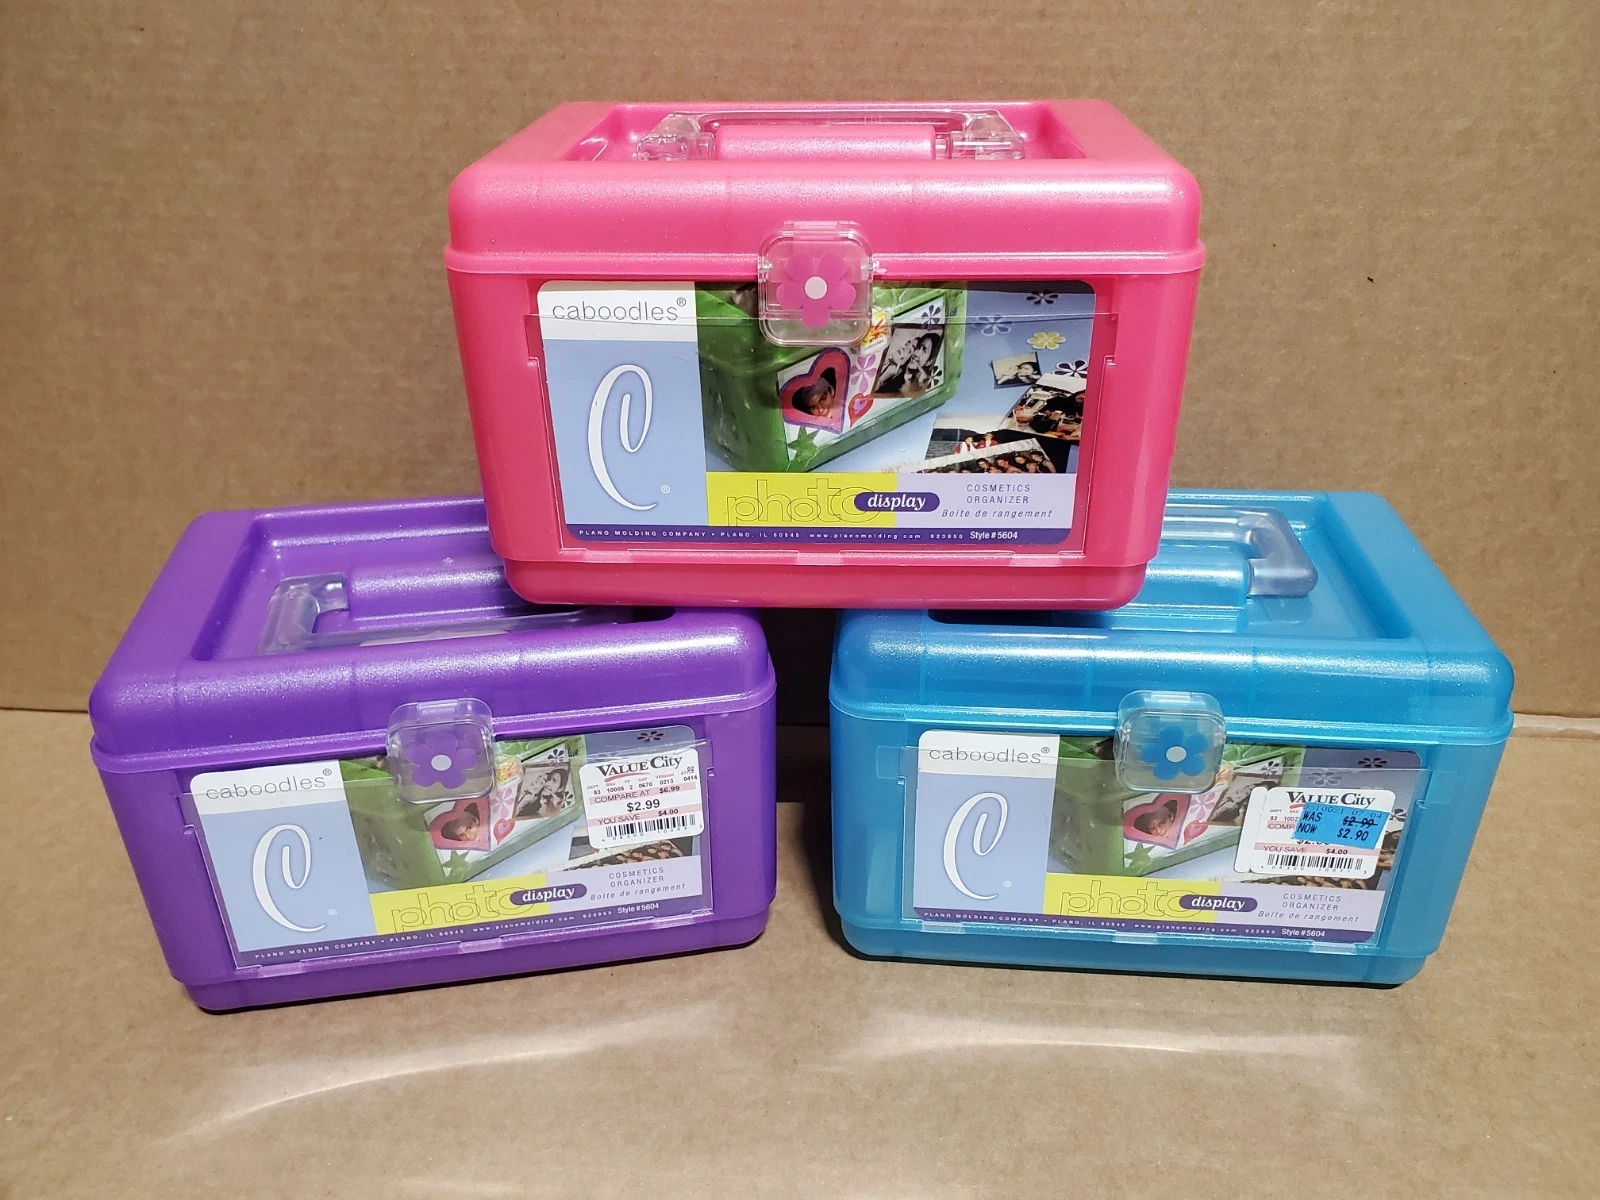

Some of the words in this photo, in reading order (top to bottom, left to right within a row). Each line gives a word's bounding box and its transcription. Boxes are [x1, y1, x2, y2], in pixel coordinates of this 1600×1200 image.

[587, 364, 656, 511] C
[966, 484, 1031, 492] COSMETICS
[726, 478, 881, 527] photo
[867, 494, 927, 511] display
[966, 496, 1030, 504] ORGANIZER
[975, 509, 988, 518] de
[992, 510, 1053, 519] rangement
[970, 531, 990, 540] Style
[597, 760, 649, 777] VALUE
[650, 755, 683, 769] City
[595, 791, 638, 803] COMPARE
[639, 789, 651, 797] AT
[659, 786, 680, 794] $6.99
[1286, 791, 1339, 805] VALUE
[1340, 792, 1377, 809] City
[626, 799, 661, 812] $2.99
[598, 815, 616, 825] YOU
[618, 813, 641, 822] SAVE
[658, 808, 679, 817] $4.00
[1302, 810, 1323, 822] WAS
[1297, 822, 1318, 834] NOW
[1336, 828, 1369, 841] $2.90
[609, 867, 665, 880] COSMETICS
[610, 876, 665, 888] ORGANIZER
[619, 889, 631, 897] de
[634, 883, 686, 896] rangement
[1060, 880, 1202, 918] photo
[1191, 897, 1246, 911] display
[1283, 893, 1342, 903] COSMETICS
[391, 885, 535, 934] photo
[522, 886, 575, 902] display
[1281, 902, 1339, 911] ORGANIZER
[1288, 912, 1300, 920] de
[1303, 914, 1360, 923] rangement
[254, 951, 285, 959] PLANO
[289, 945, 330, 955] MOLDING
[334, 940, 377, 949] COMPANY
[617, 906, 635, 915] Style
[1281, 928, 1299, 937] Style
